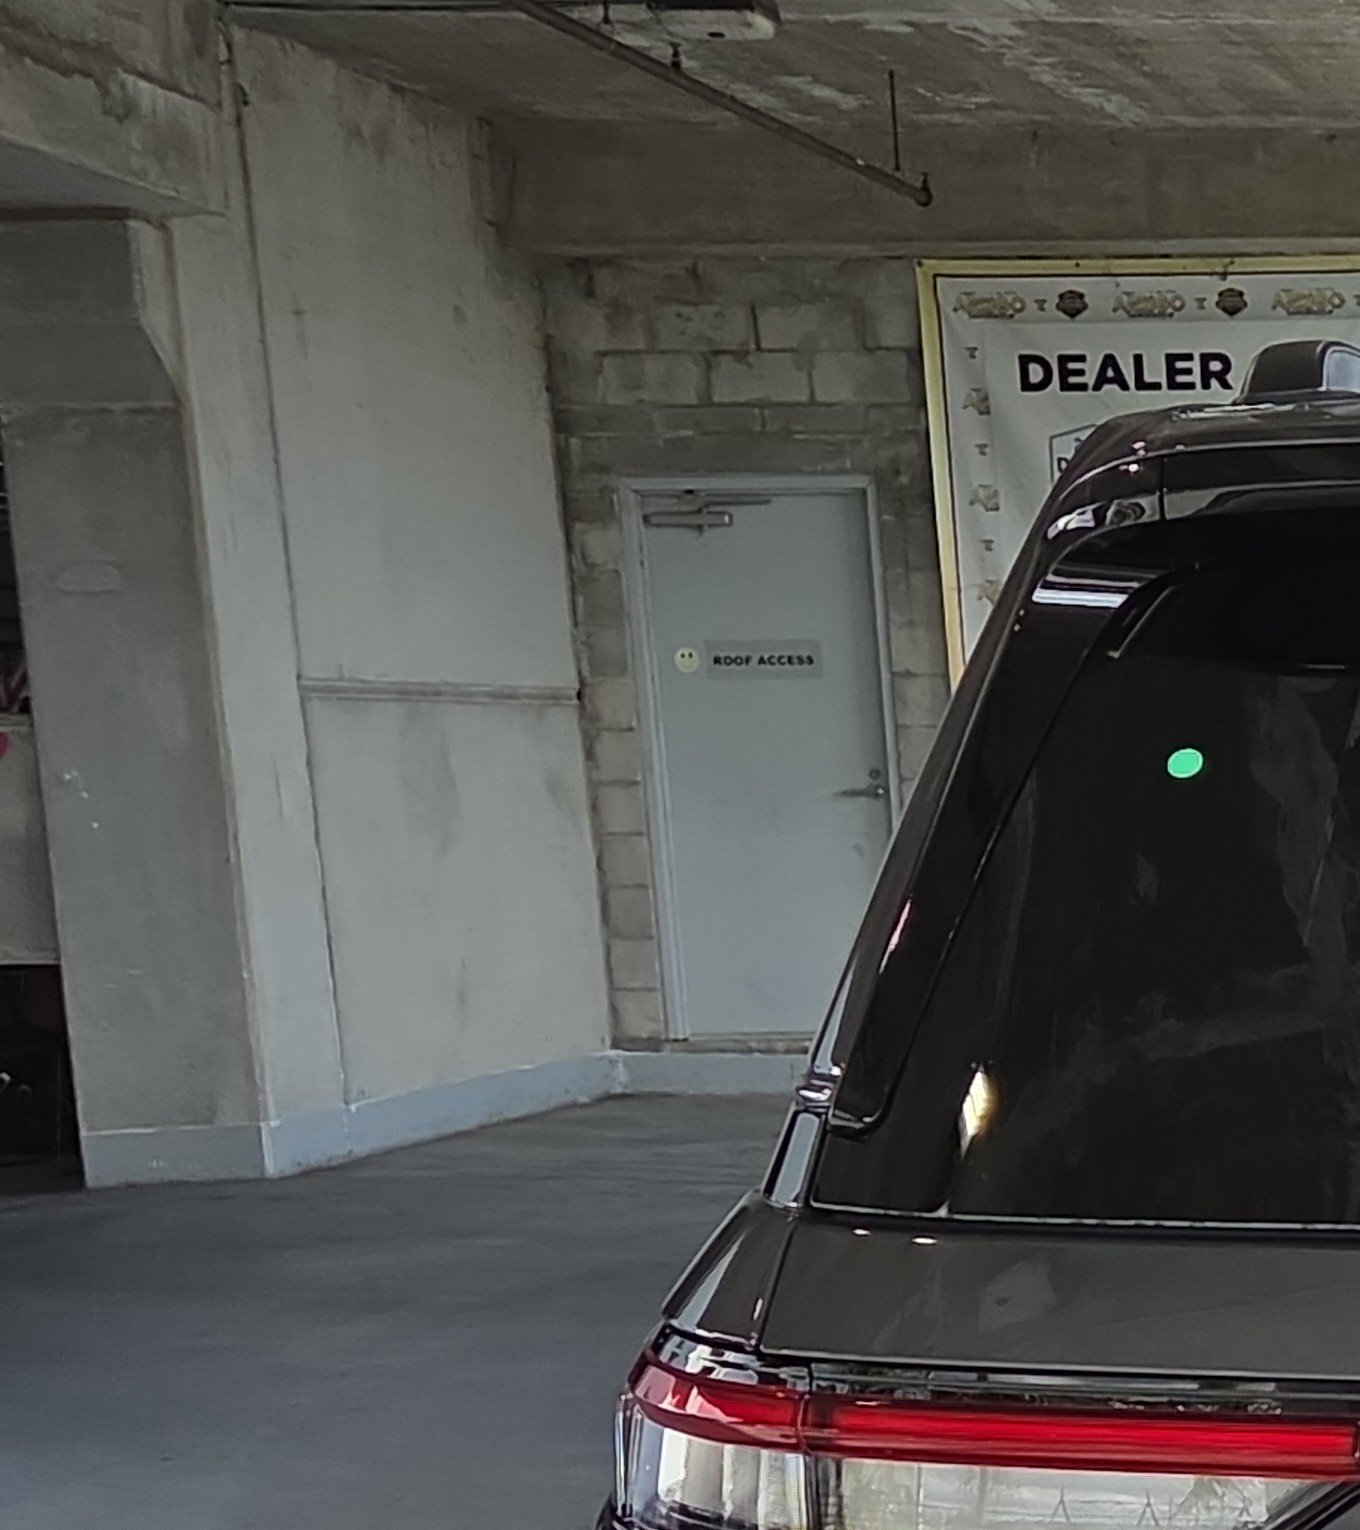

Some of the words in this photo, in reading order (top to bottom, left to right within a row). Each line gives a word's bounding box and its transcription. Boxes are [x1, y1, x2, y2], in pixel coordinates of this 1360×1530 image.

[1018, 352, 1232, 392] DEALER
[713, 654, 752, 666] ROOF
[757, 653, 814, 666] ACCESS
